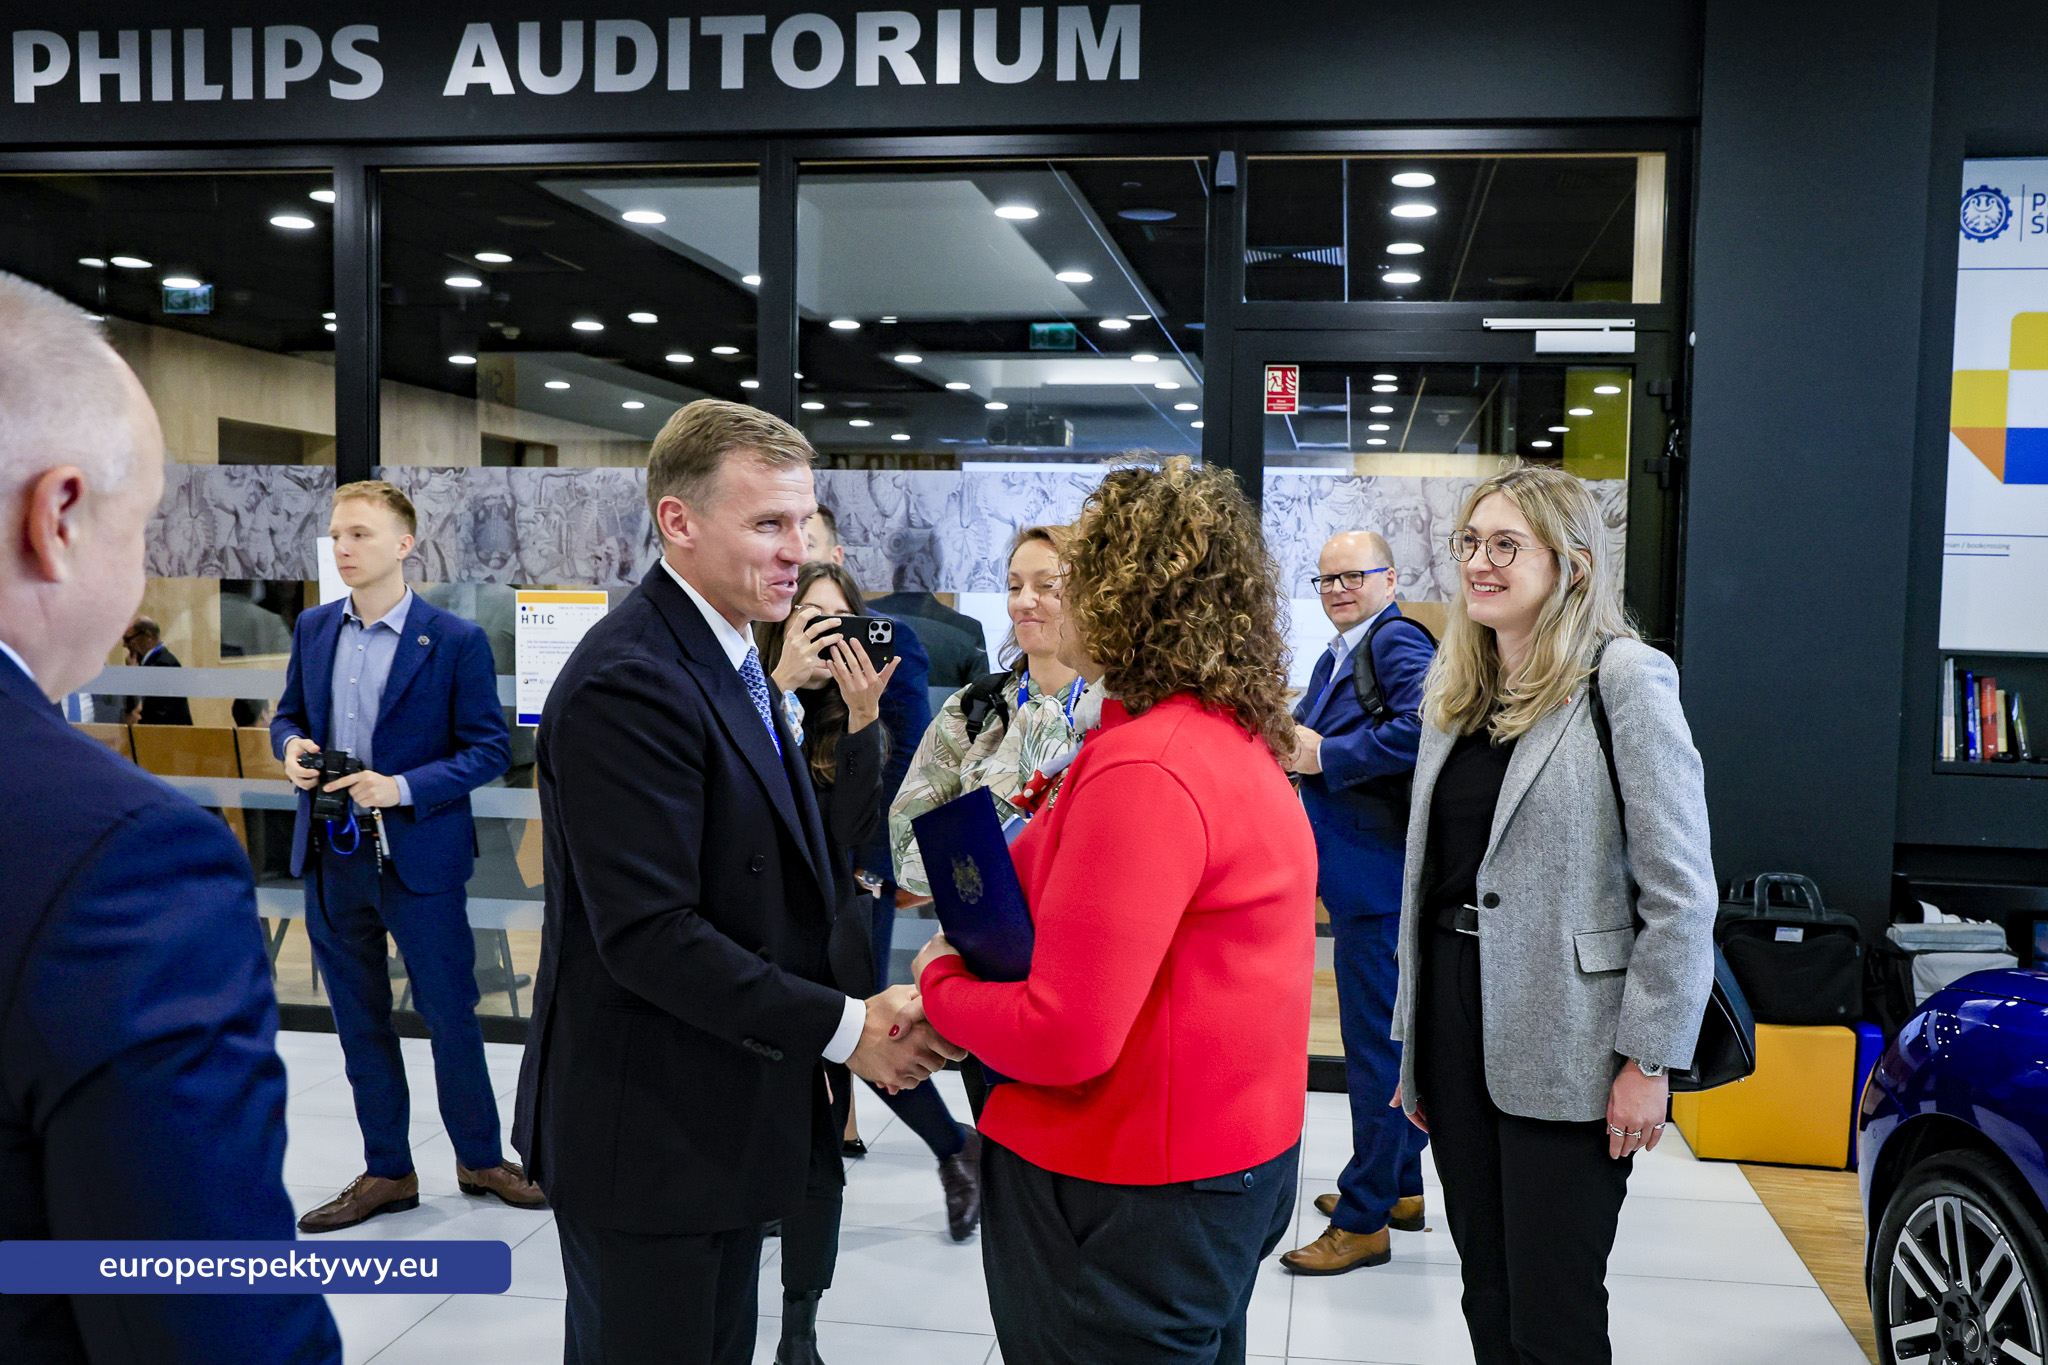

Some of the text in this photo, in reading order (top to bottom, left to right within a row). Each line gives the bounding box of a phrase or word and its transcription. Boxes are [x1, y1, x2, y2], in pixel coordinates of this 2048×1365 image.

[13, 4, 1141, 103] PHILIPS AUDITORIUM
[2032, 192, 2048, 212] P
[521, 614, 555, 625] HTIC
